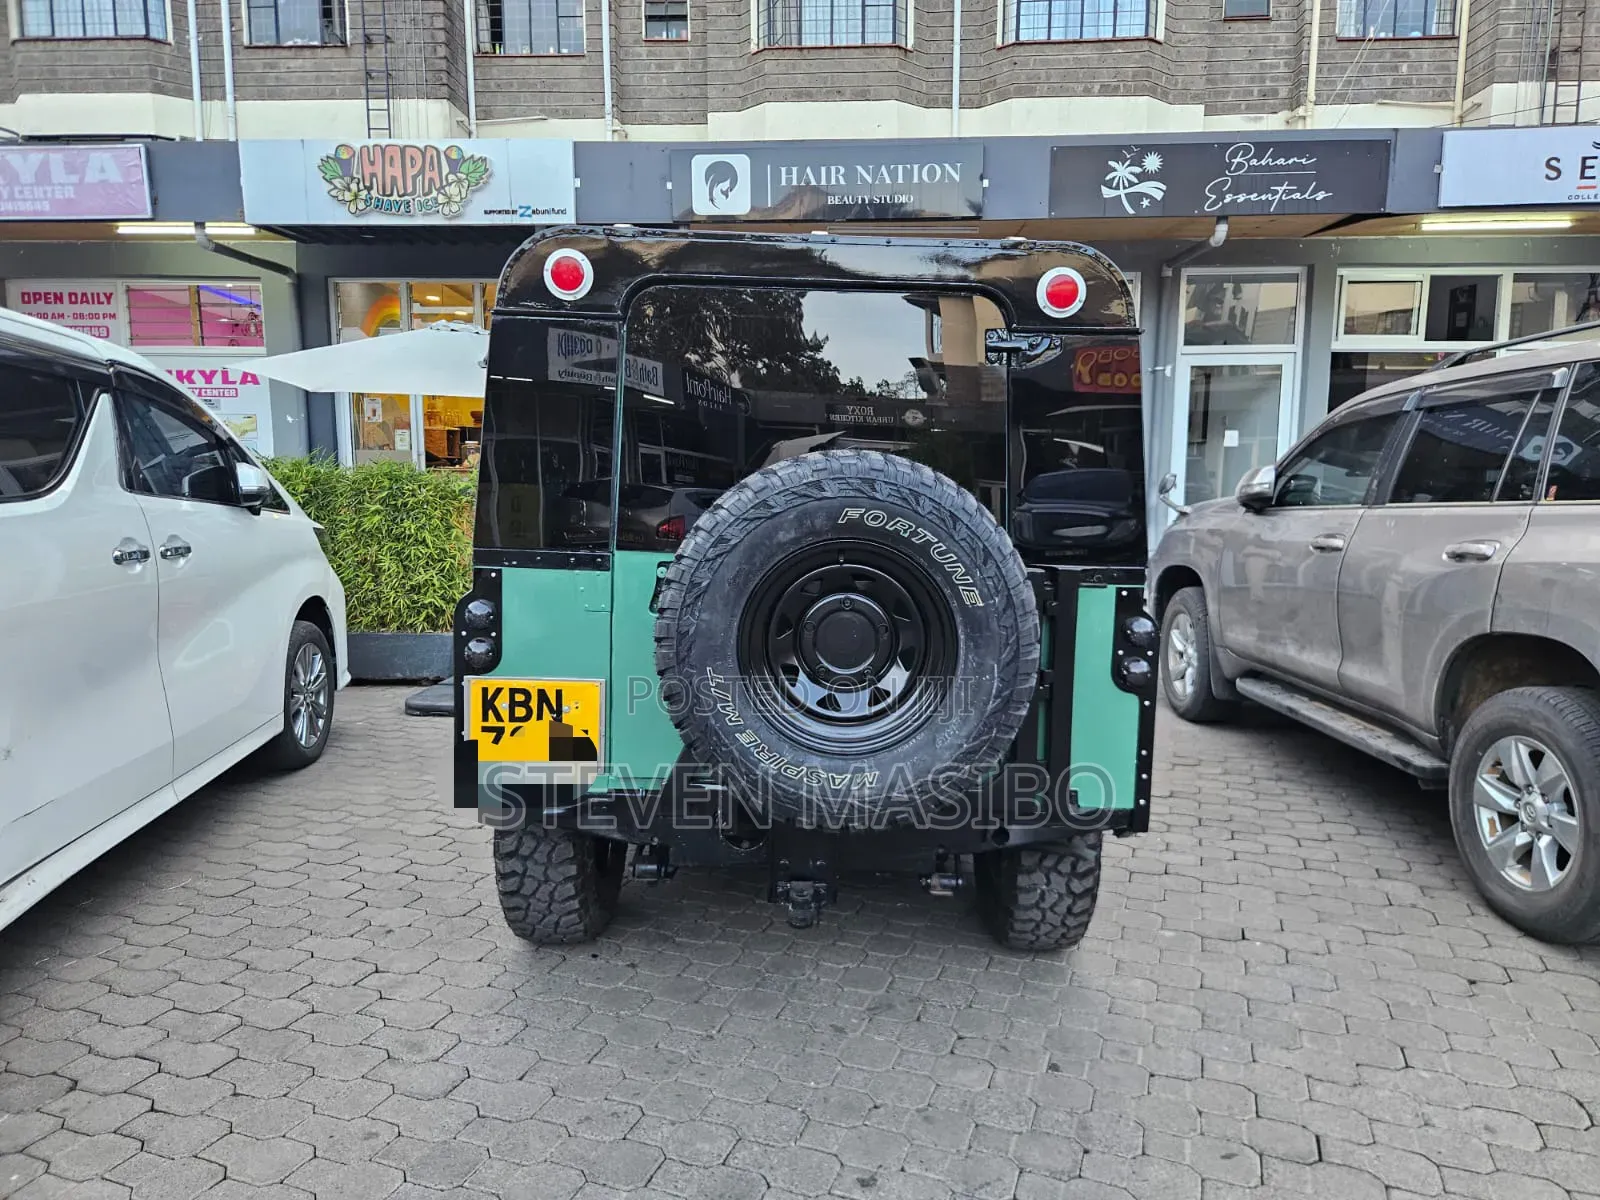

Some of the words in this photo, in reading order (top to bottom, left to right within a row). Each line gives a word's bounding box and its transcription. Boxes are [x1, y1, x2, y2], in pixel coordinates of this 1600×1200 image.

[360, 144, 443, 197] HAPA
[1225, 142, 1317, 176] Bahari
[779, 165, 847, 187] HAIR
[855, 162, 963, 185] NATION
[14, 184, 76, 199] CENTER
[364, 193, 411, 213] SHAVE
[827, 195, 869, 205] BEAUTY
[872, 194, 913, 204] STUDIO
[1204, 177, 1333, 212] Essentials
[20, 292, 64, 305] OPEN
[67, 292, 114, 305] DAILY
[51, 312, 65, 320] AM
[102, 312, 117, 320] PM
[201, 388, 237, 397] CENTER
[838, 507, 984, 607] FORTUNE
[481, 686, 563, 723] KBN
[706, 667, 744, 726] M/T
[735, 729, 880, 790] MASPIRE
